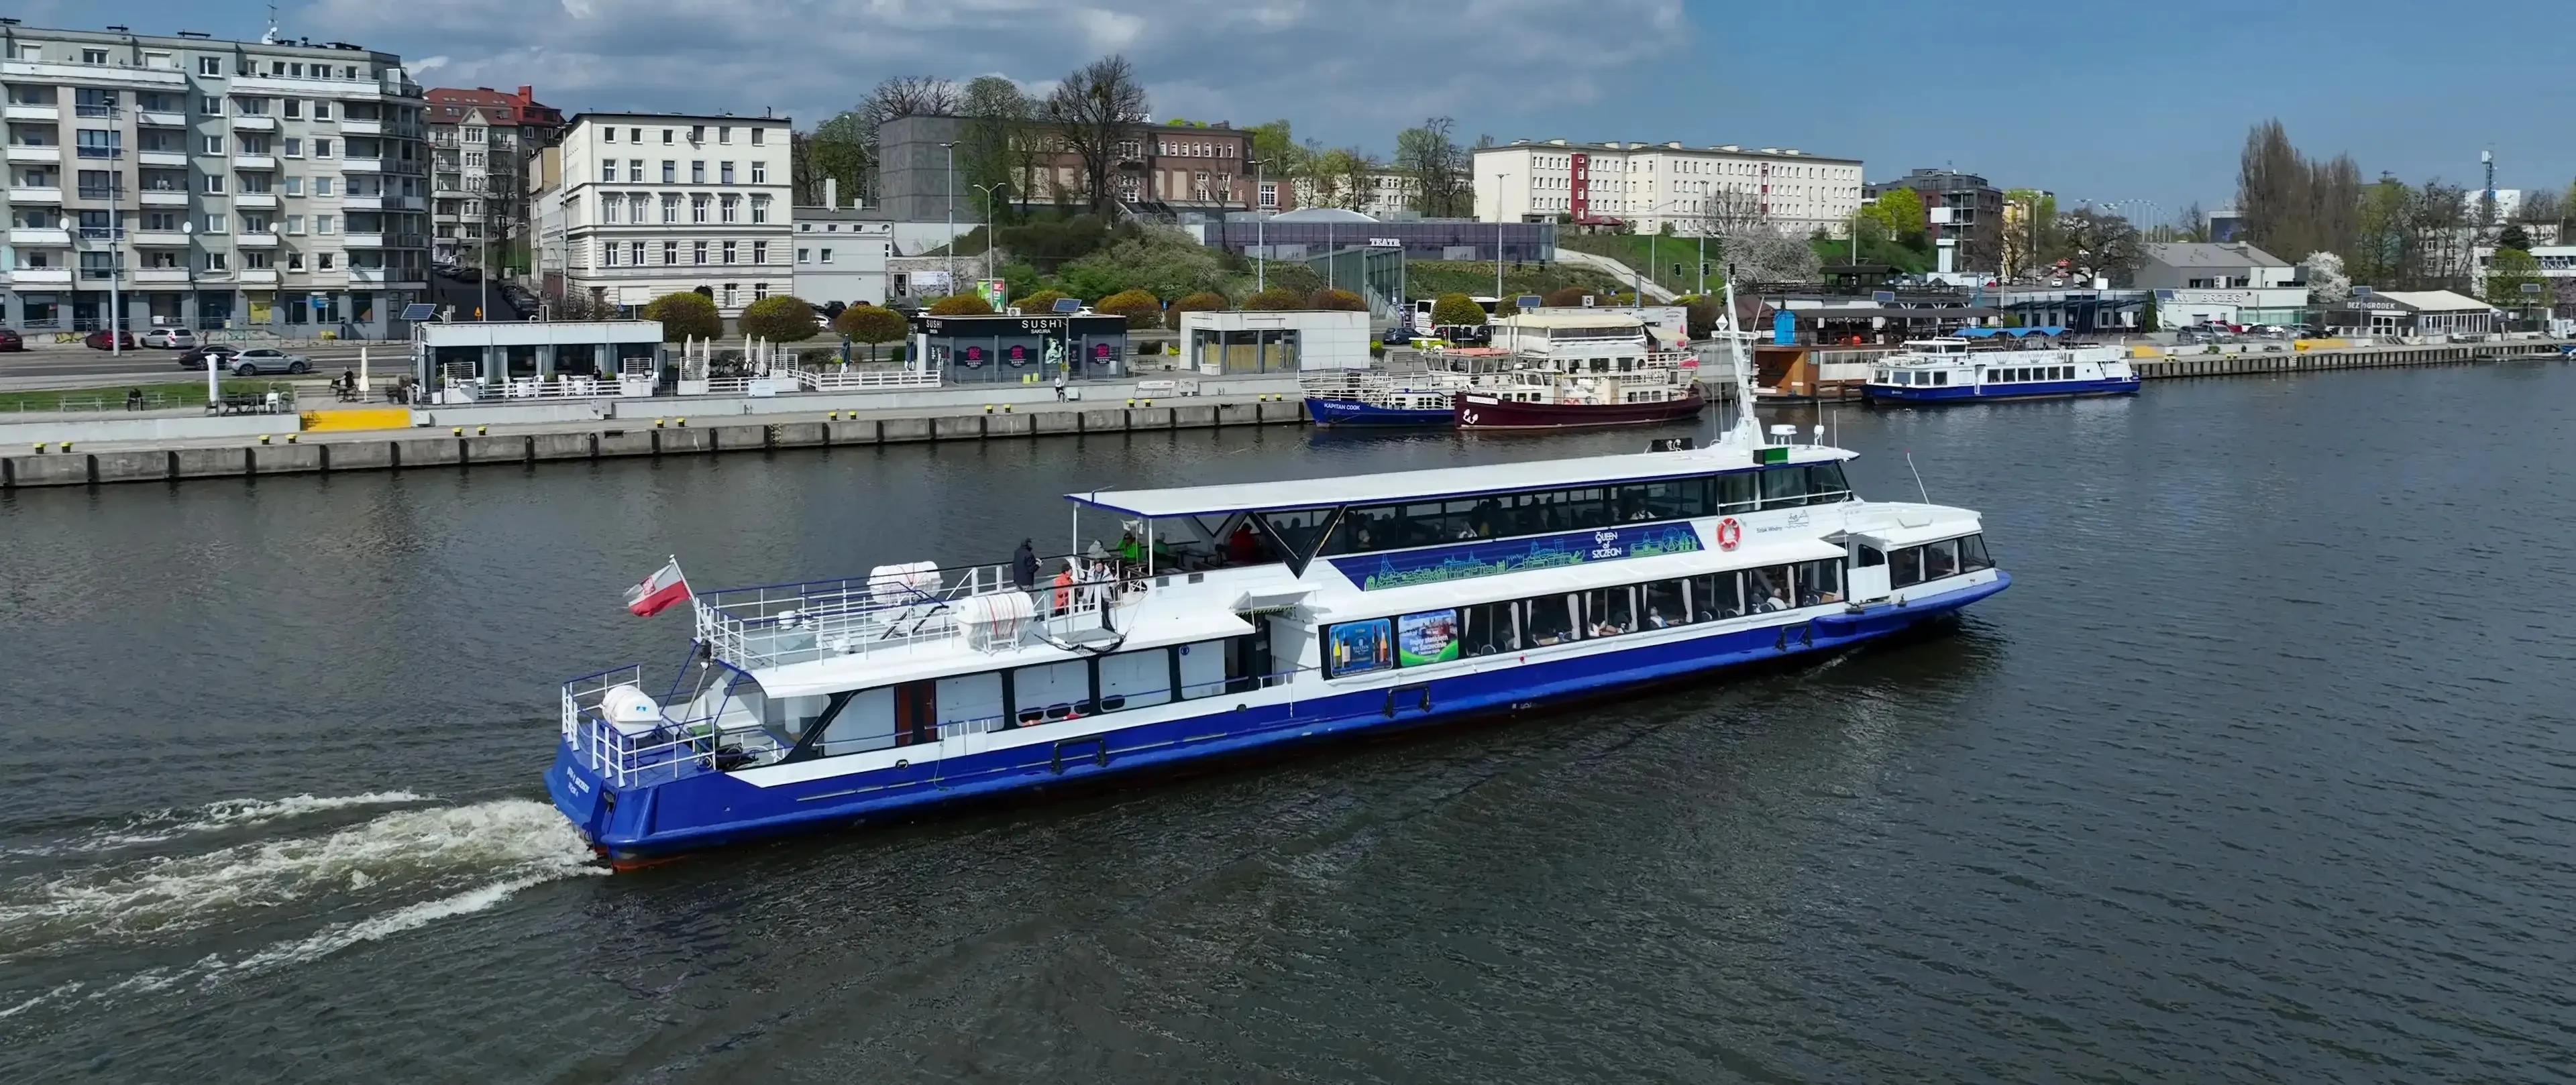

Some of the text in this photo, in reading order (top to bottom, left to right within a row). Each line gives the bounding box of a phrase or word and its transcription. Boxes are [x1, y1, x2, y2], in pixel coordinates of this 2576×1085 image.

[1370, 238, 1401, 247] TEATR
[2201, 294, 2241, 302] BRZEG
[926, 320, 942, 328] SUSHI
[1022, 320, 1062, 329] SUSHI
[1595, 532, 1618, 544] QUEEN
[1603, 540, 1610, 549] of
[1592, 547, 1622, 559] SZCZECIN
